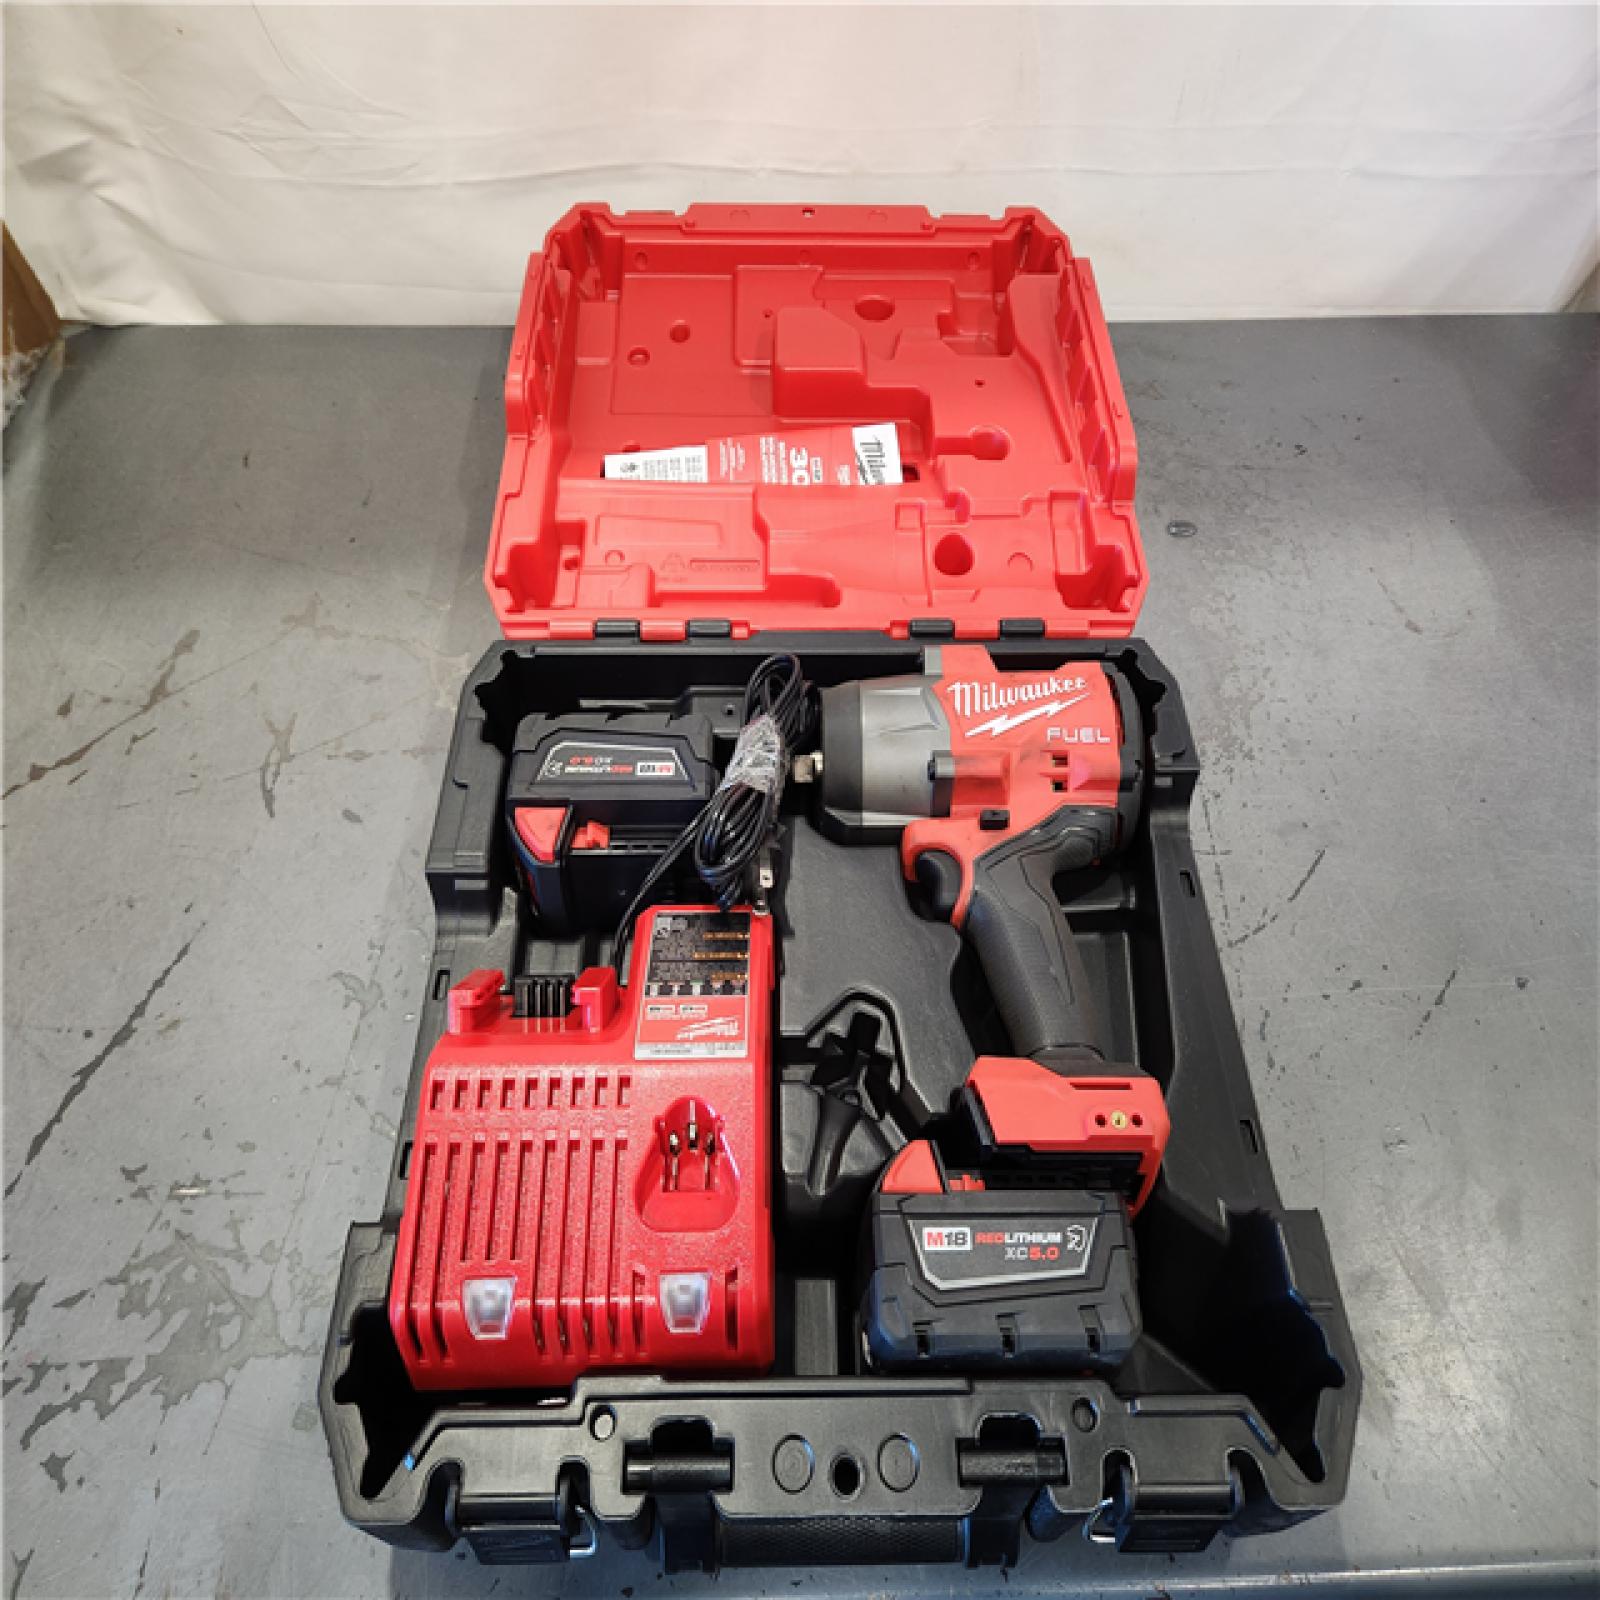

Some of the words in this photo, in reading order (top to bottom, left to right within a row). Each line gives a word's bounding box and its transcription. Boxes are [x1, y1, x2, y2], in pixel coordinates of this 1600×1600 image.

[947, 676, 1088, 718] Milwaukee
[1046, 726, 1111, 744] FUEL
[926, 1231, 968, 1247] M18
[974, 1231, 1063, 1244] REDLITHIUM
[1004, 1246, 1060, 1261] XC5.0
